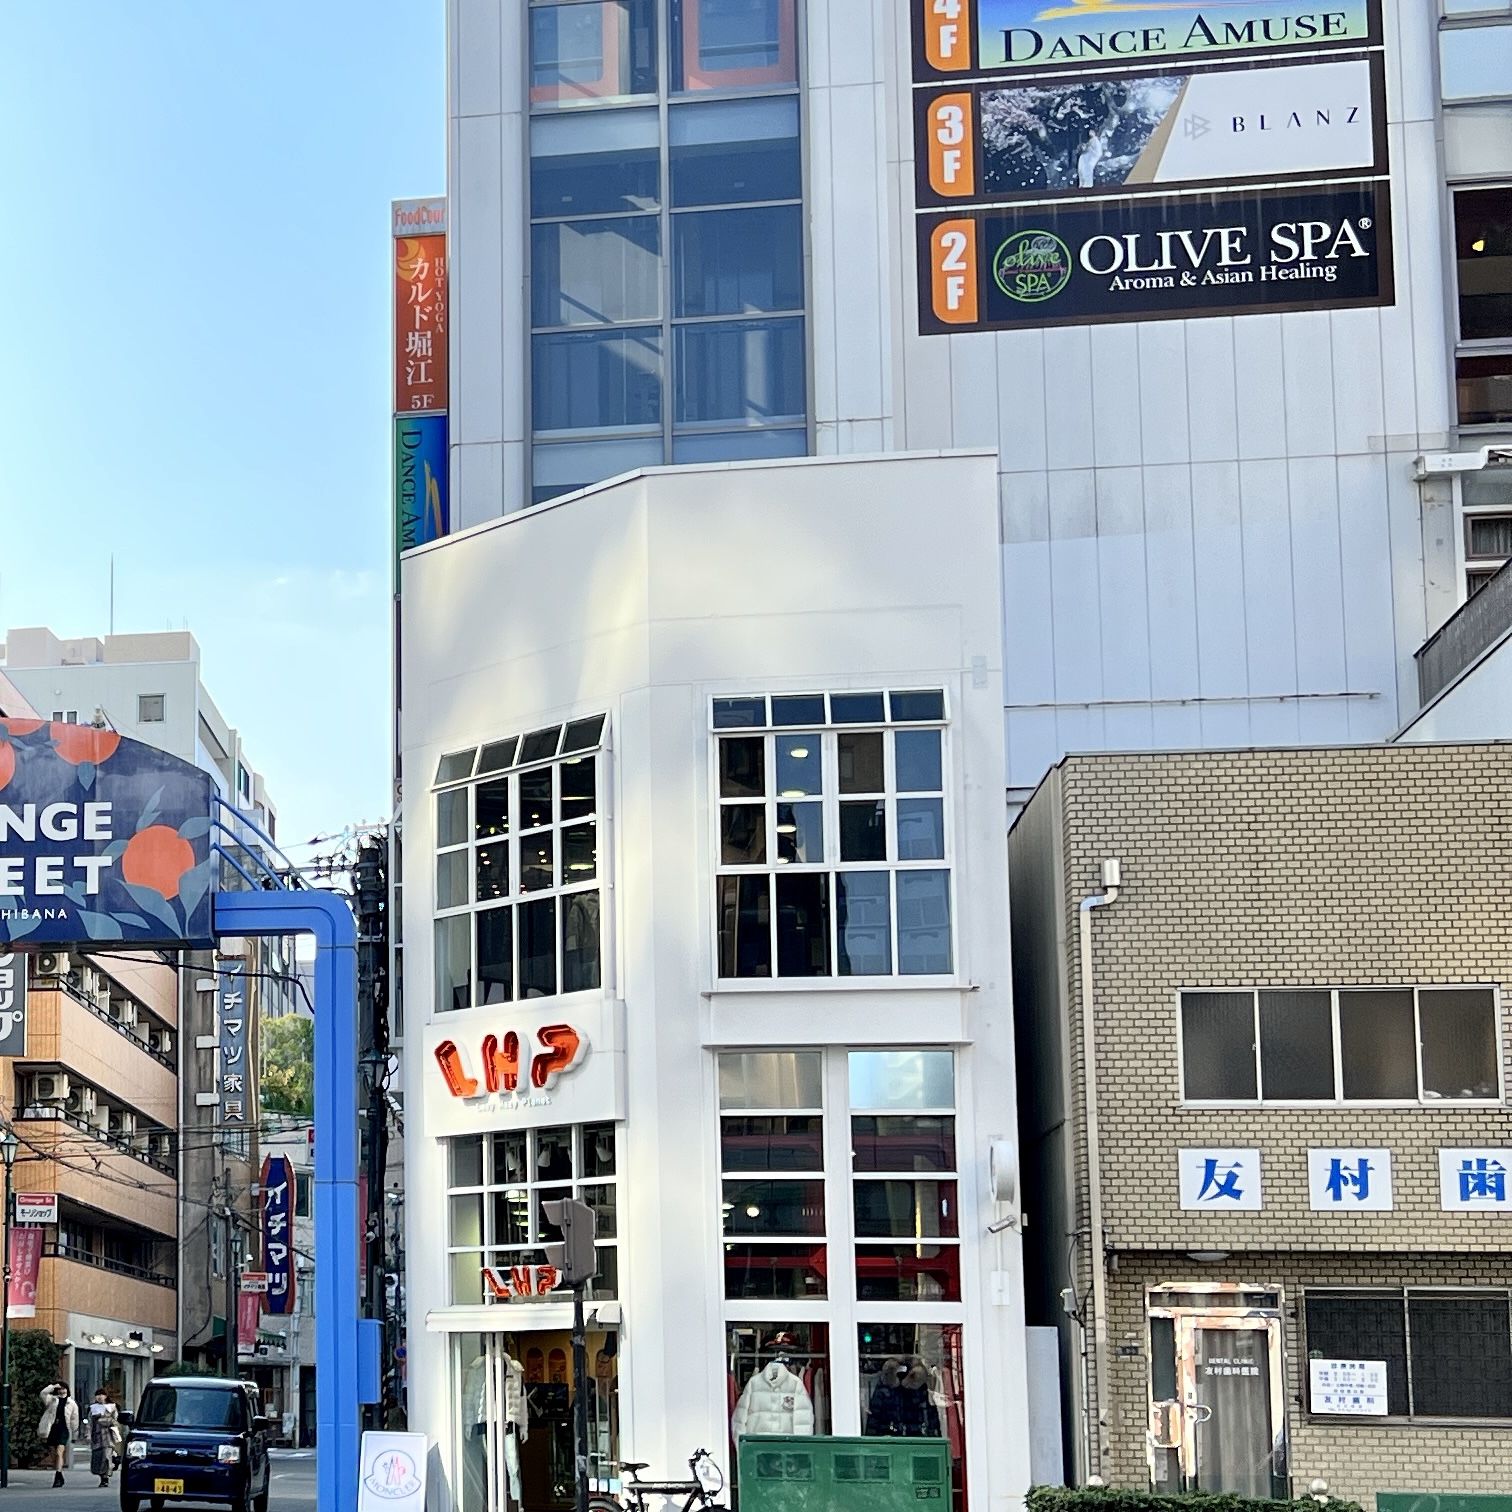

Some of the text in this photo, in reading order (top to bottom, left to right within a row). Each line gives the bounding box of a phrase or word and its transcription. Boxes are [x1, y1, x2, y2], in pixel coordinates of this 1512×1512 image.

[999, 12, 1349, 63] DANCE AMUSE
[1232, 106, 1360, 133] BLANZ
[1003, 239, 1062, 268] olive
[1079, 226, 1251, 275] OLIVE
[434, 257, 445, 333] HOT YOGA
[1108, 262, 1338, 292] Aroma & Asian Healing
[405, 256, 434, 387] カルド堀江
[411, 394, 435, 410] 5F
[401, 430, 423, 505] DANCE
[223, 963, 244, 1121] イチマツ家具
[434, 1023, 589, 1099] LHP
[264, 1181, 288, 1296] イチマツ
[481, 1265, 560, 1297] LHP
[369, 1477, 417, 1496] MONCLER
